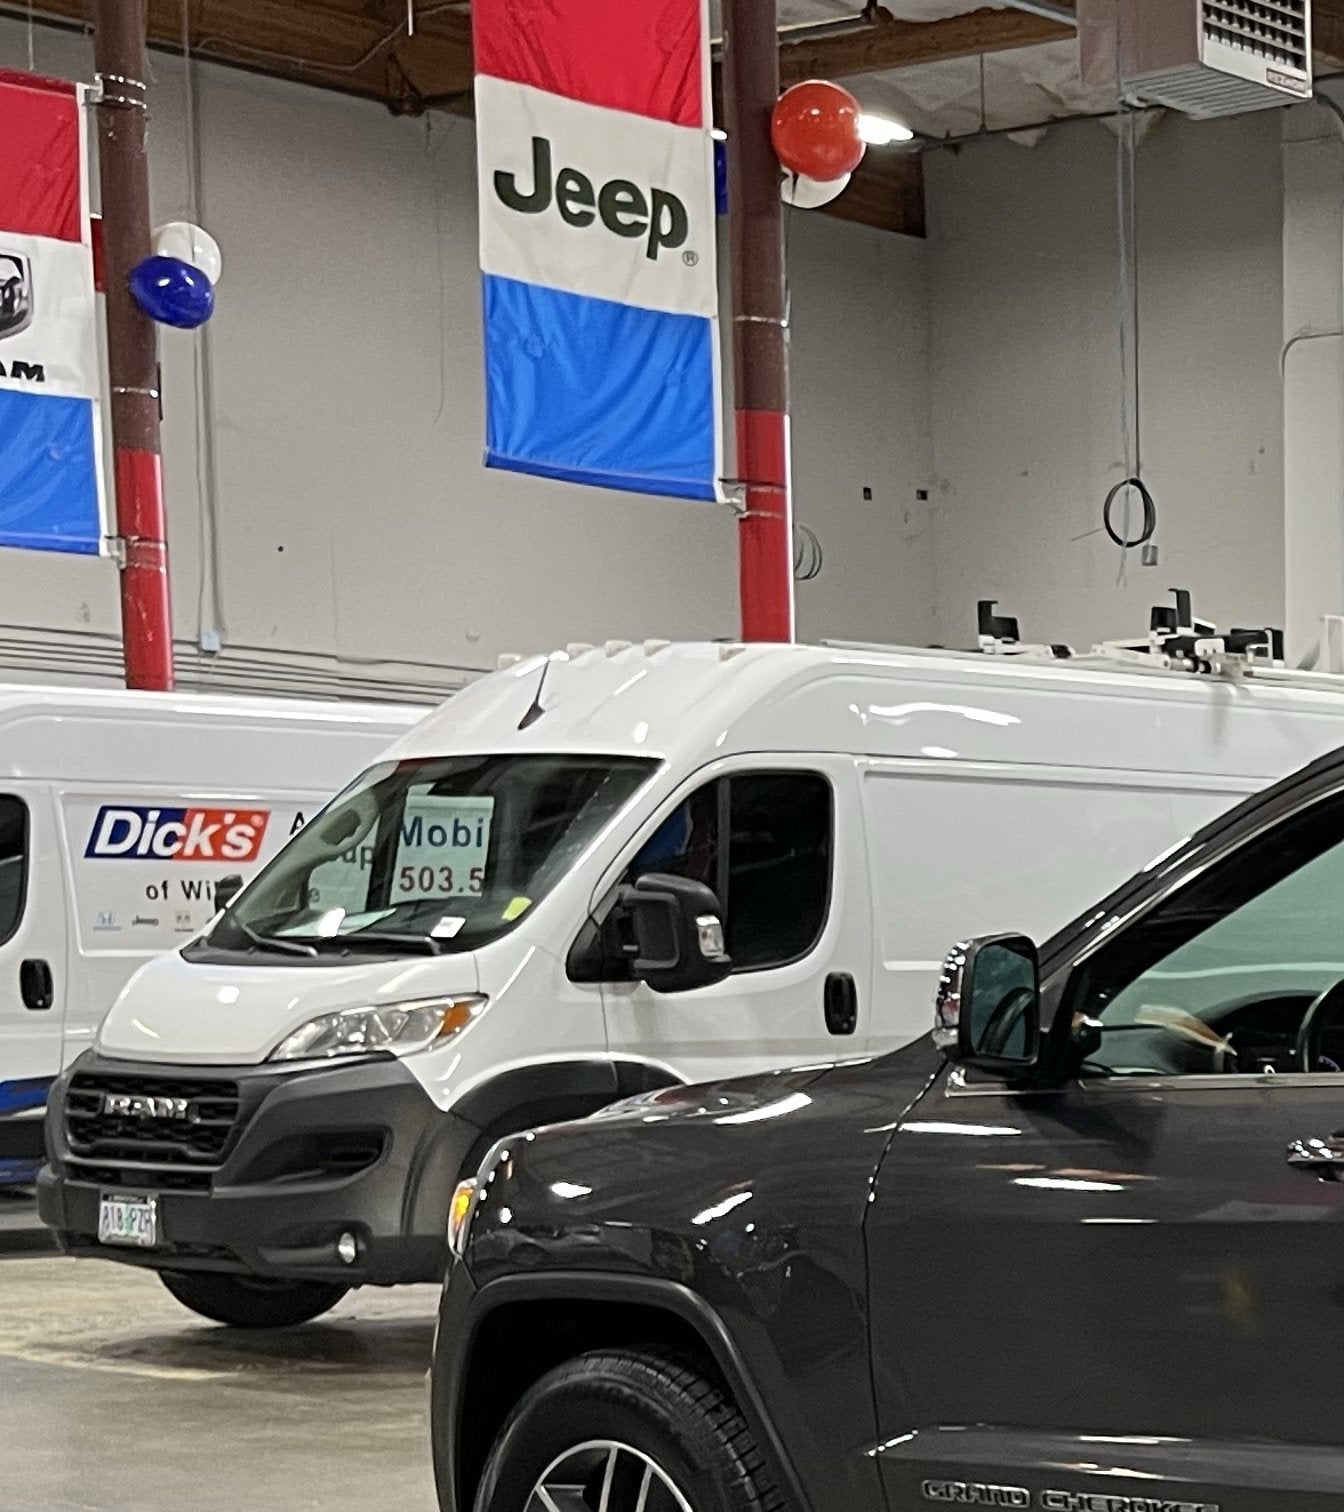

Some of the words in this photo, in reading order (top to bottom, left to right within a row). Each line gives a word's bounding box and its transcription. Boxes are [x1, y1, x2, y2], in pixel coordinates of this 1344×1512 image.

[493, 135, 689, 261] Jeep
[145, 879, 169, 900] of
[921, 1479, 1031, 1509] GRAND
